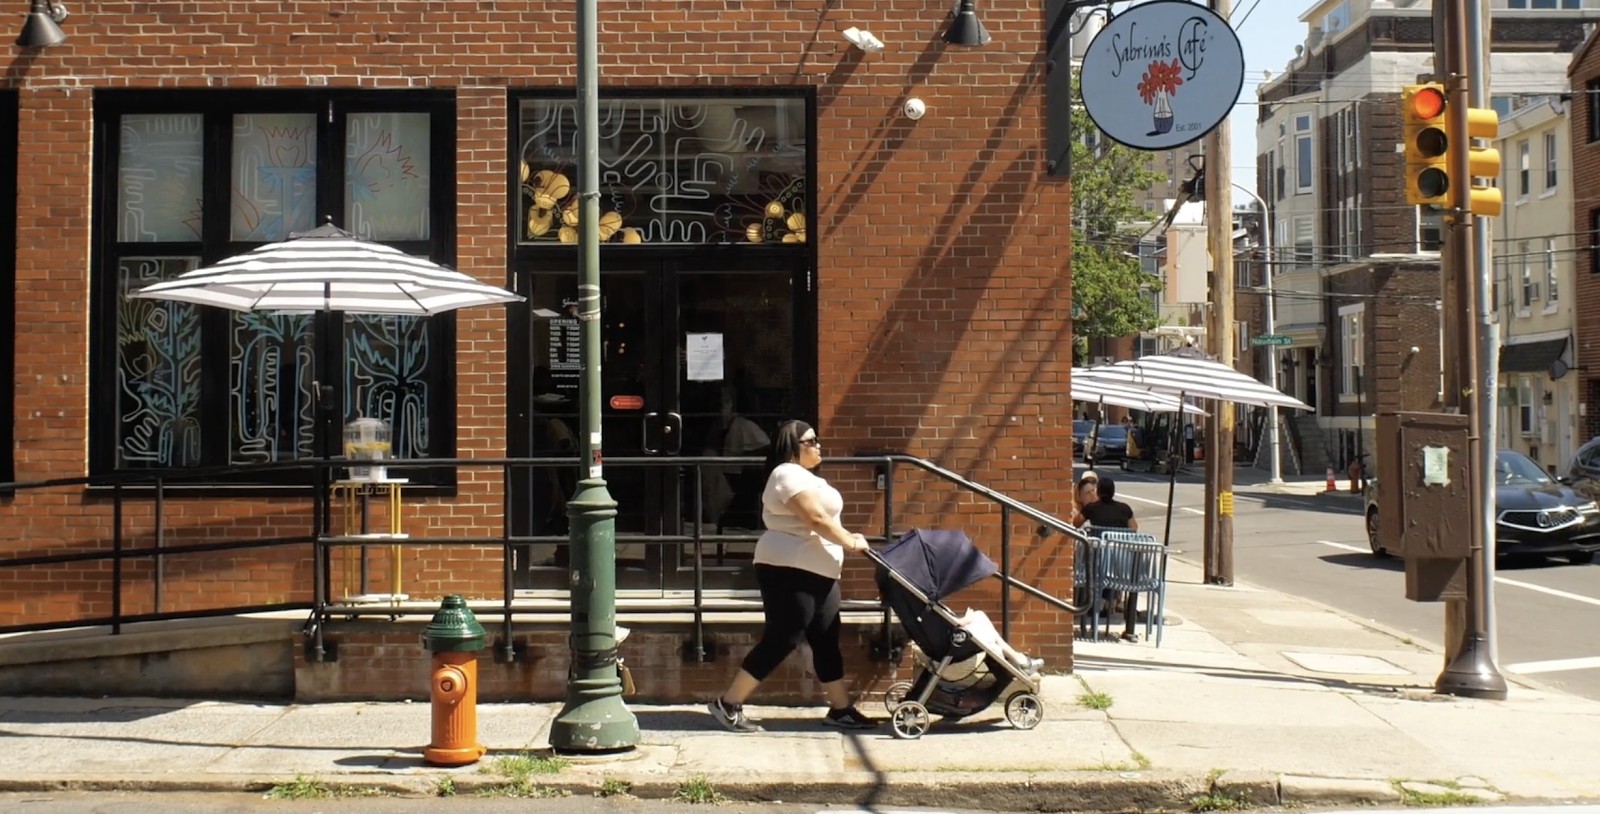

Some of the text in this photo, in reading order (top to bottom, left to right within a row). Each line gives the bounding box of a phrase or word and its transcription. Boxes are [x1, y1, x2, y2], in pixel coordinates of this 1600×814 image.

[1111, 16, 1209, 81] Sabrina's Café
[1175, 122, 1202, 133] Est. 2001
